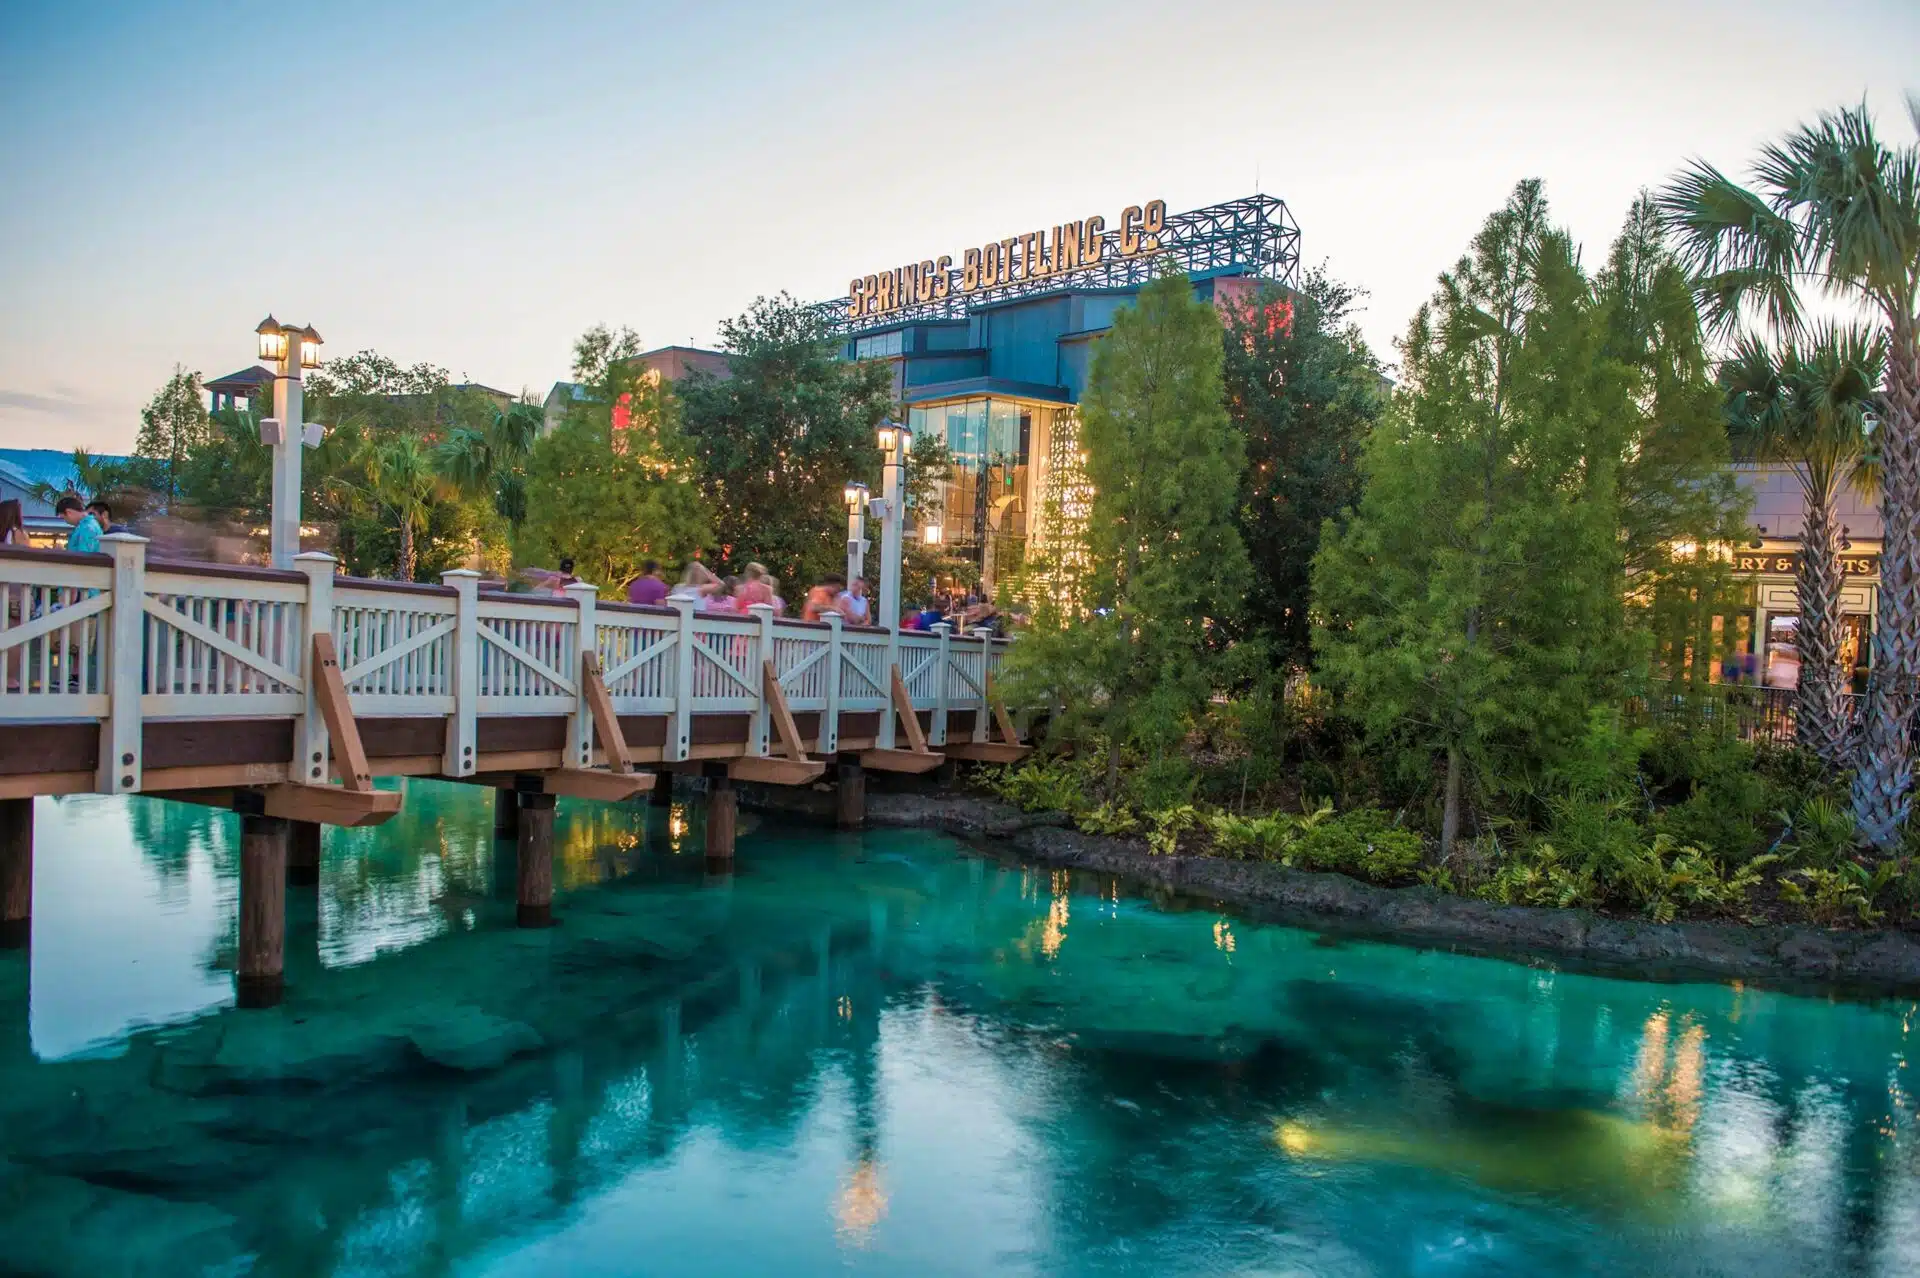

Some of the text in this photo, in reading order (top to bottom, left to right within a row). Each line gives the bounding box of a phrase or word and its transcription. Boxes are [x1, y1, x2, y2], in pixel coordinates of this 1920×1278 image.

[848, 255, 952, 317] SPRINGS
[964, 215, 1105, 292] BOTTLING
[1775, 558, 1793, 571] &
